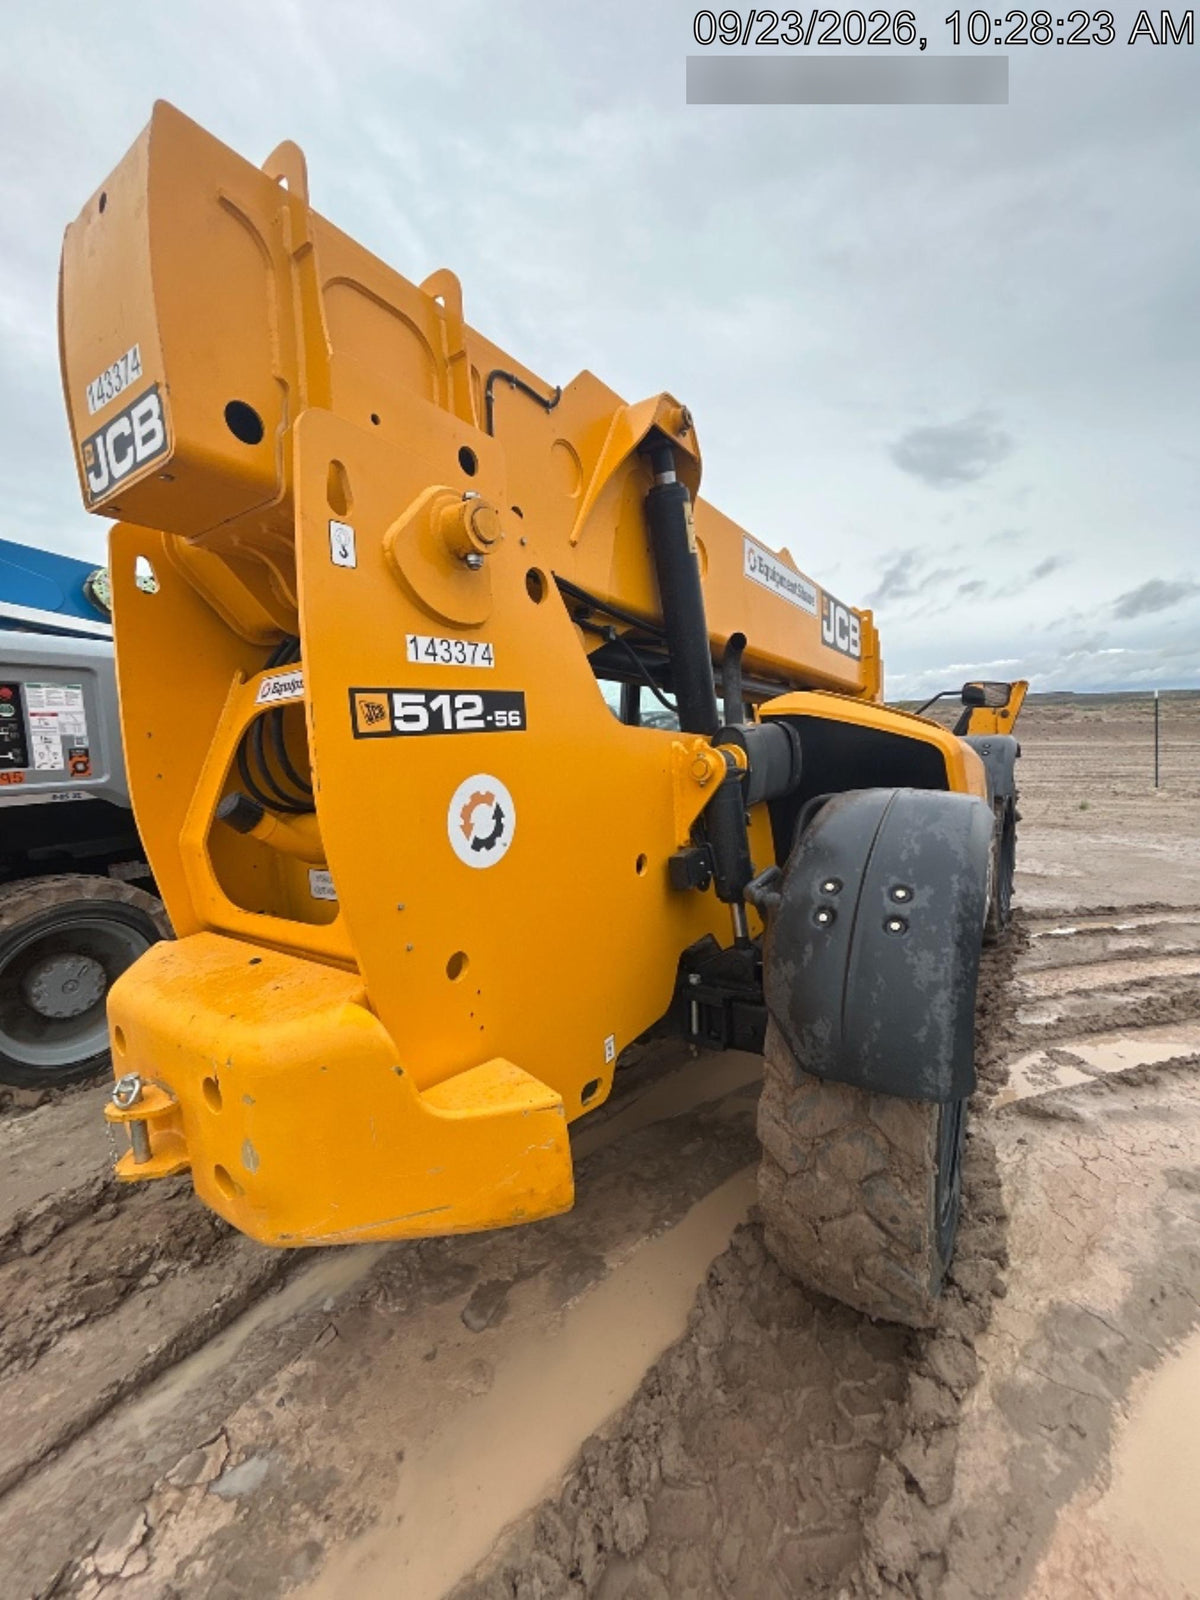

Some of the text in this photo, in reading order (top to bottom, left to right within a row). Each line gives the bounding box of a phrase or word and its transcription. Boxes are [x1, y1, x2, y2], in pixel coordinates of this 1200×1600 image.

[88, 346, 141, 411] 143374
[87, 393, 165, 494] JCB
[409, 636, 494, 665] 143374
[822, 599, 861, 657] JCB
